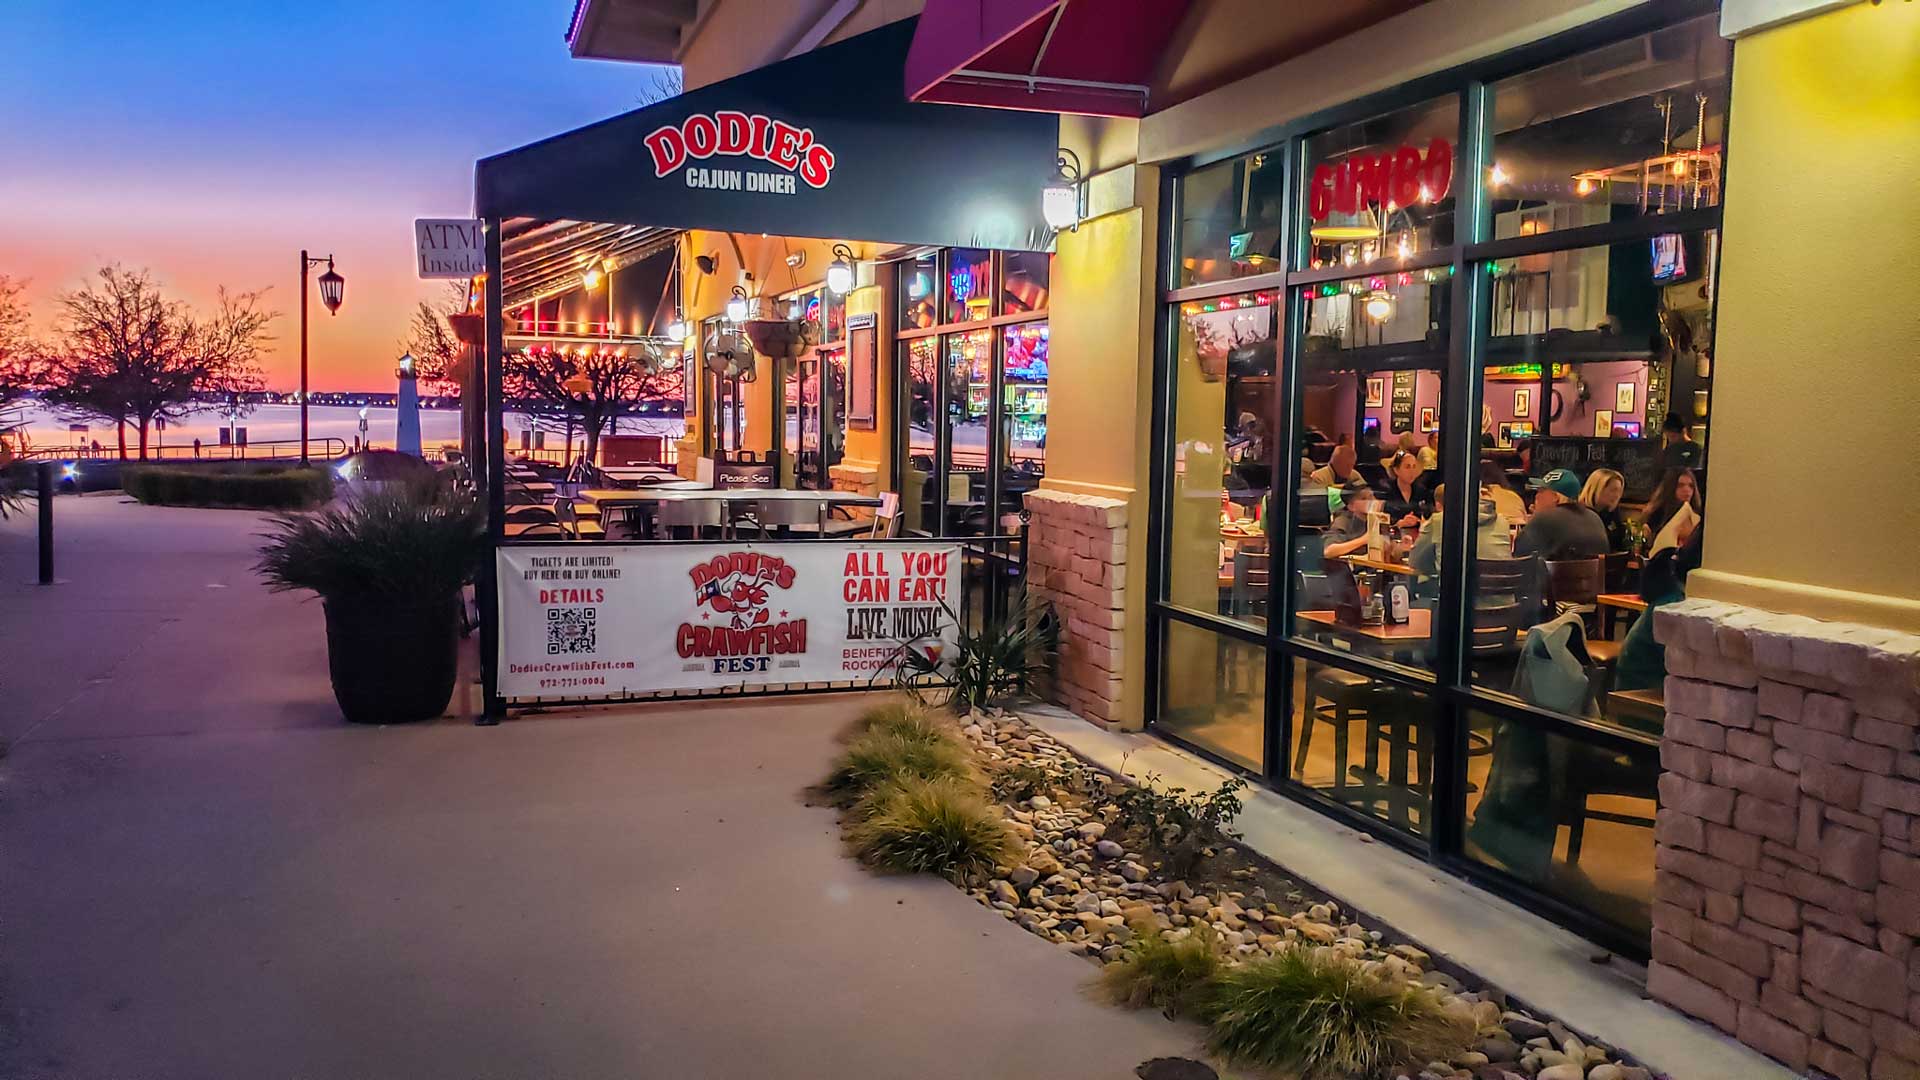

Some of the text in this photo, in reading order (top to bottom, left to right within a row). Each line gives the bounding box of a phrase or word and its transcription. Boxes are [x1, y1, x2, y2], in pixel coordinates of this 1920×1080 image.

[643, 110, 835, 189] DODIE'S
[686, 167, 796, 195] CAJUN DINER
[1309, 137, 1453, 221] GUMBO
[421, 224, 477, 250] ATM
[421, 254, 482, 273] Inside
[720, 474, 769, 483] Please See
[531, 556, 614, 567] TICKETS ARE LIMITED!
[843, 552, 948, 576] ALL YOU
[524, 569, 621, 581] BUY HERE OR BUY ONLINE!
[540, 588, 604, 604] DETAILS
[843, 577, 947, 602] CAN EAT!
[846, 607, 942, 640] LIVE MUSIC
[676, 619, 807, 659] CRAWFISH
[713, 656, 771, 674] FEST
